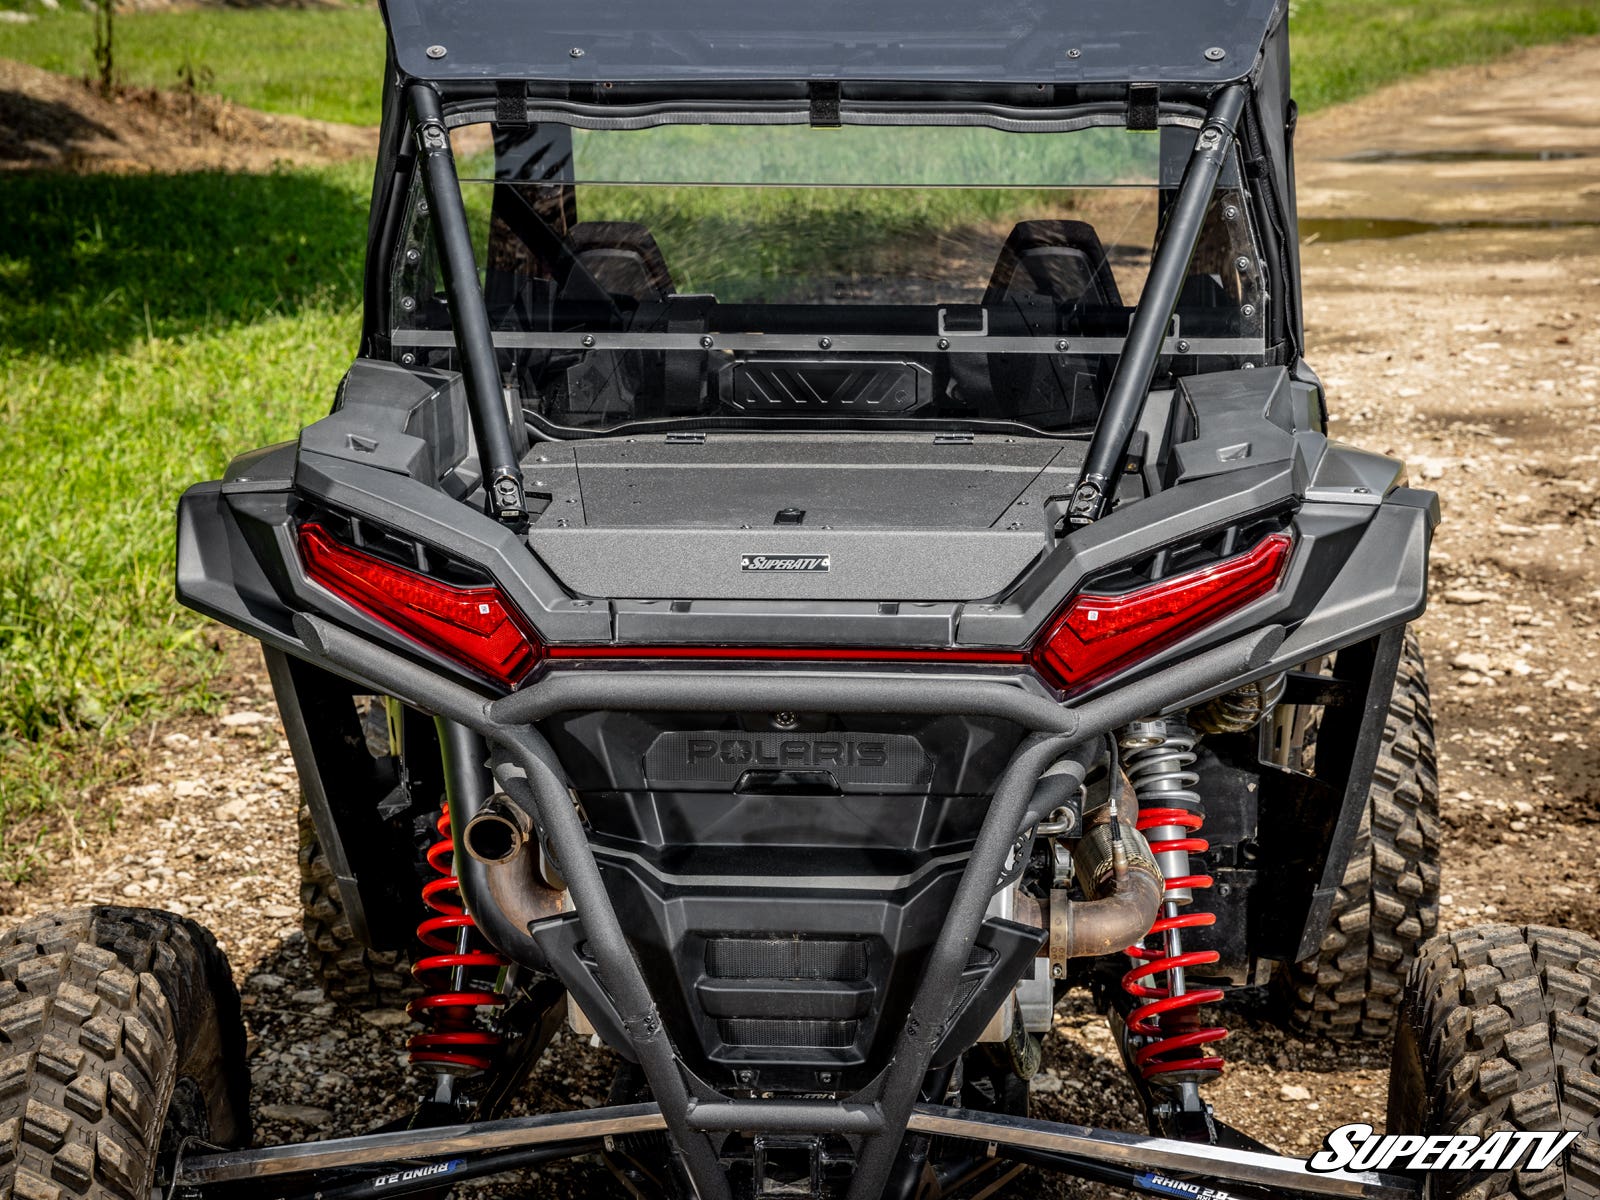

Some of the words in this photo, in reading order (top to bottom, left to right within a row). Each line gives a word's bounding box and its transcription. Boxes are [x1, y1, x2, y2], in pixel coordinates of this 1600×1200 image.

[748, 556, 822, 570] SUPERATV
[686, 739, 888, 767] POLARIS
[375, 1174, 400, 1187] 2.0
[402, 1162, 449, 1181] RHINO
[1152, 1174, 1201, 1194] RHINO
[1202, 1187, 1229, 1200] 2.0
